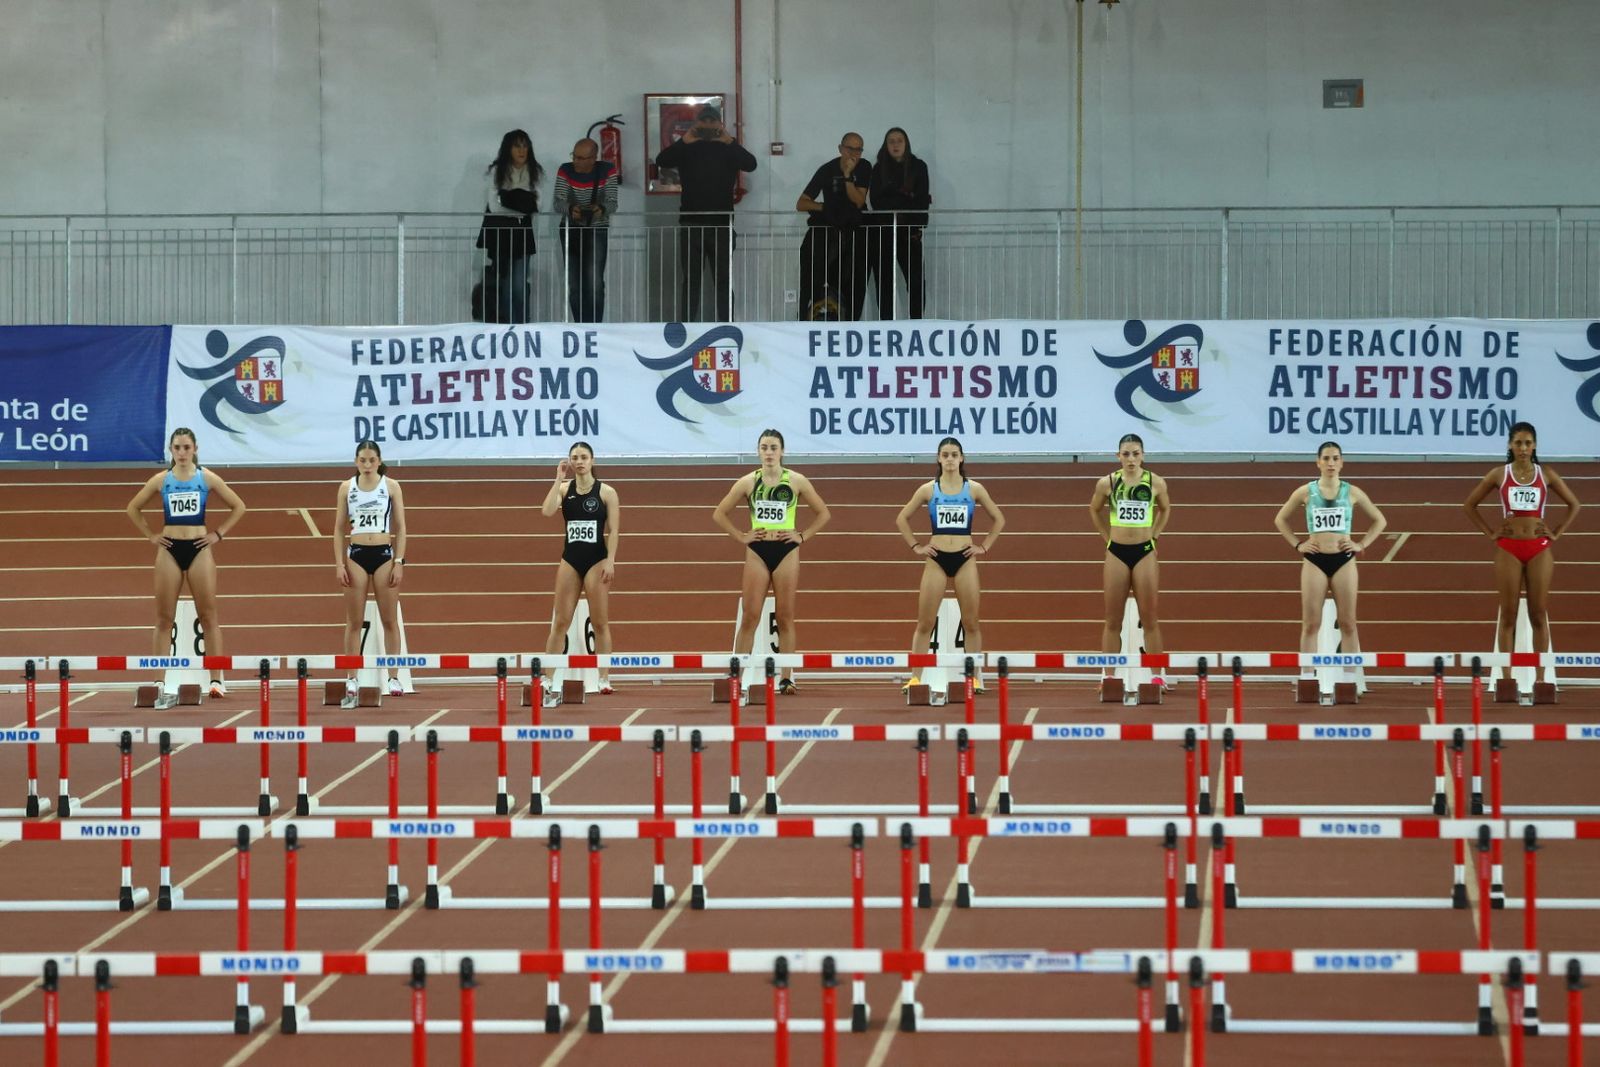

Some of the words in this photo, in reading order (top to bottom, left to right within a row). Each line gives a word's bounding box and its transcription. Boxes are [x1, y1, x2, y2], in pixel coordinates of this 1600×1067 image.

[351, 326, 541, 365] FEDERACIÓN
[562, 331, 598, 358] DE
[808, 324, 1000, 357] FEDERACIÓN
[1022, 329, 1057, 356] DE
[1269, 325, 1462, 357] FEDERACIÓN
[1484, 331, 1519, 358] DE
[353, 367, 598, 407] ATLETISMO
[809, 365, 1057, 398] ATLETISMO
[1268, 365, 1518, 400] ATLETISMO
[51, 398, 88, 421] de
[354, 416, 386, 442] DE
[392, 410, 508, 441] CASTILLA
[512, 410, 528, 436] Y
[534, 404, 598, 436] LEÓN
[810, 408, 842, 434] DE
[848, 408, 964, 434] CASTILLA
[970, 408, 986, 434] Y
[992, 402, 1056, 434] LEÓN
[1268, 406, 1300, 434] DE
[1306, 407, 1424, 435] CASTILLA
[1429, 408, 1446, 436] Y
[1452, 404, 1516, 436] LEÓN
[16, 428, 88, 452] León
[1513, 492, 1536, 502] 1702
[171, 498, 198, 512] 7045
[757, 508, 784, 520] 2556
[938, 512, 965, 524] 7044
[1120, 507, 1146, 520] 2553
[360, 514, 378, 527] 241
[1315, 514, 1342, 528] 3107
[568, 526, 594, 540] 2956
[139, 658, 190, 668] MONDO
[376, 657, 427, 666] MONDO
[610, 656, 661, 666] MONDO
[844, 656, 895, 666] MONDO
[1077, 656, 1128, 666] MONDO
[1312, 656, 1364, 665] MONDO
[254, 730, 305, 740] MONDO
[516, 728, 574, 740] MONDO
[1048, 727, 1105, 738] MONDO
[1314, 727, 1372, 738] MONDO
[80, 826, 141, 836] MONDO
[389, 823, 456, 834] MONDO
[694, 823, 759, 835] MONDO
[1006, 822, 1072, 833] MONDO
[1320, 824, 1381, 834] MONDO
[221, 957, 300, 971] MONDO
[586, 956, 664, 970] MONDO
[1314, 956, 1394, 969] MONDO
